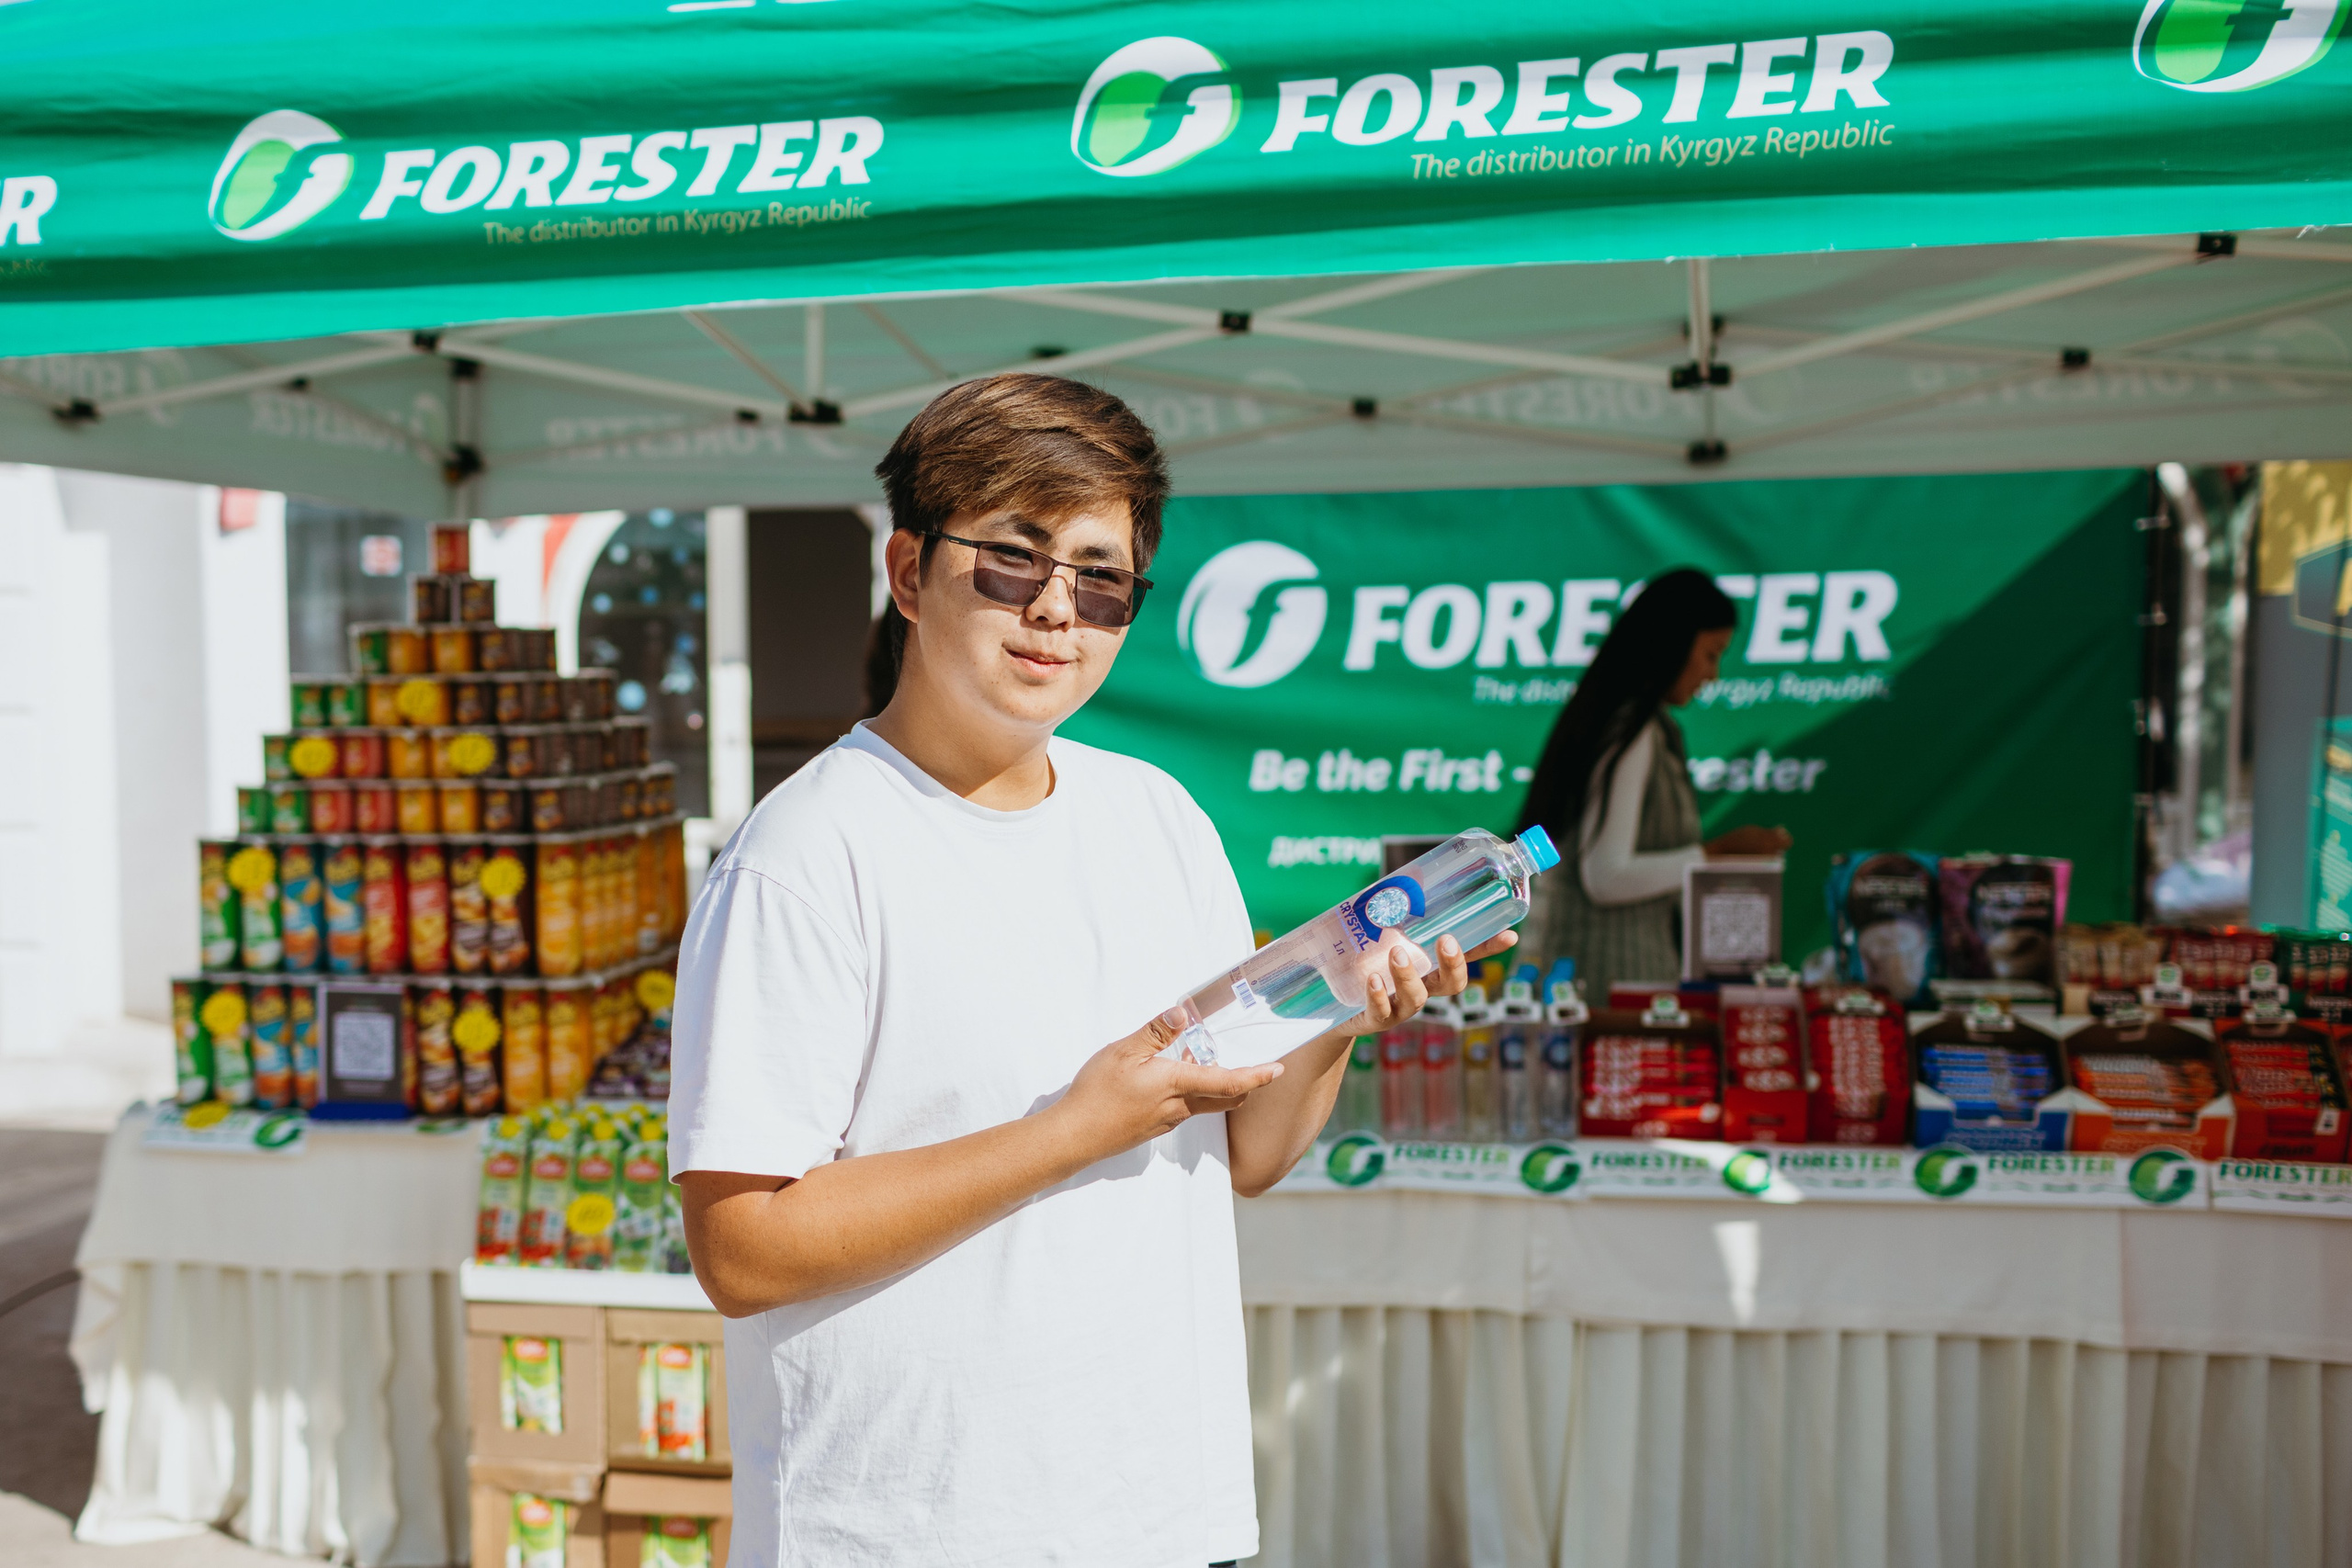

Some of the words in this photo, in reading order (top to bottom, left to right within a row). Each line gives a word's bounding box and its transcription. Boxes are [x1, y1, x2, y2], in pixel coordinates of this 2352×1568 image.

[1261, 30, 1894, 154] FORESTER
[359, 116, 884, 221] FORESTER
[1411, 152, 1458, 180] The
[1466, 143, 1619, 177] distributor
[1624, 140, 1651, 165] in
[1658, 134, 1756, 168] Kyrgyz
[1764, 120, 1896, 159] Republic
[482, 220, 524, 244] The
[529, 213, 650, 244] distributor
[656, 210, 679, 233] in
[684, 208, 762, 236] Kyrgyz
[767, 197, 873, 228] Republic
[1343, 570, 1898, 671] FOREER
[1475, 675, 1516, 705] The
[1693, 678, 1774, 710] yrgyz
[1248, 749, 1310, 792] Be
[1316, 748, 1393, 793] the
[1398, 748, 1503, 793] First
[1268, 835, 1381, 868] ДИСТРИ
[1339, 901, 1370, 952] CRYSTAL
[1392, 1143, 1510, 1163] FORESTER
[1590, 1152, 1709, 1169] FORESTER
[1778, 1152, 1903, 1170] FORESTER
[1986, 1155, 2115, 1175] FORESTER
[2218, 1161, 2352, 1184] FORESTER
